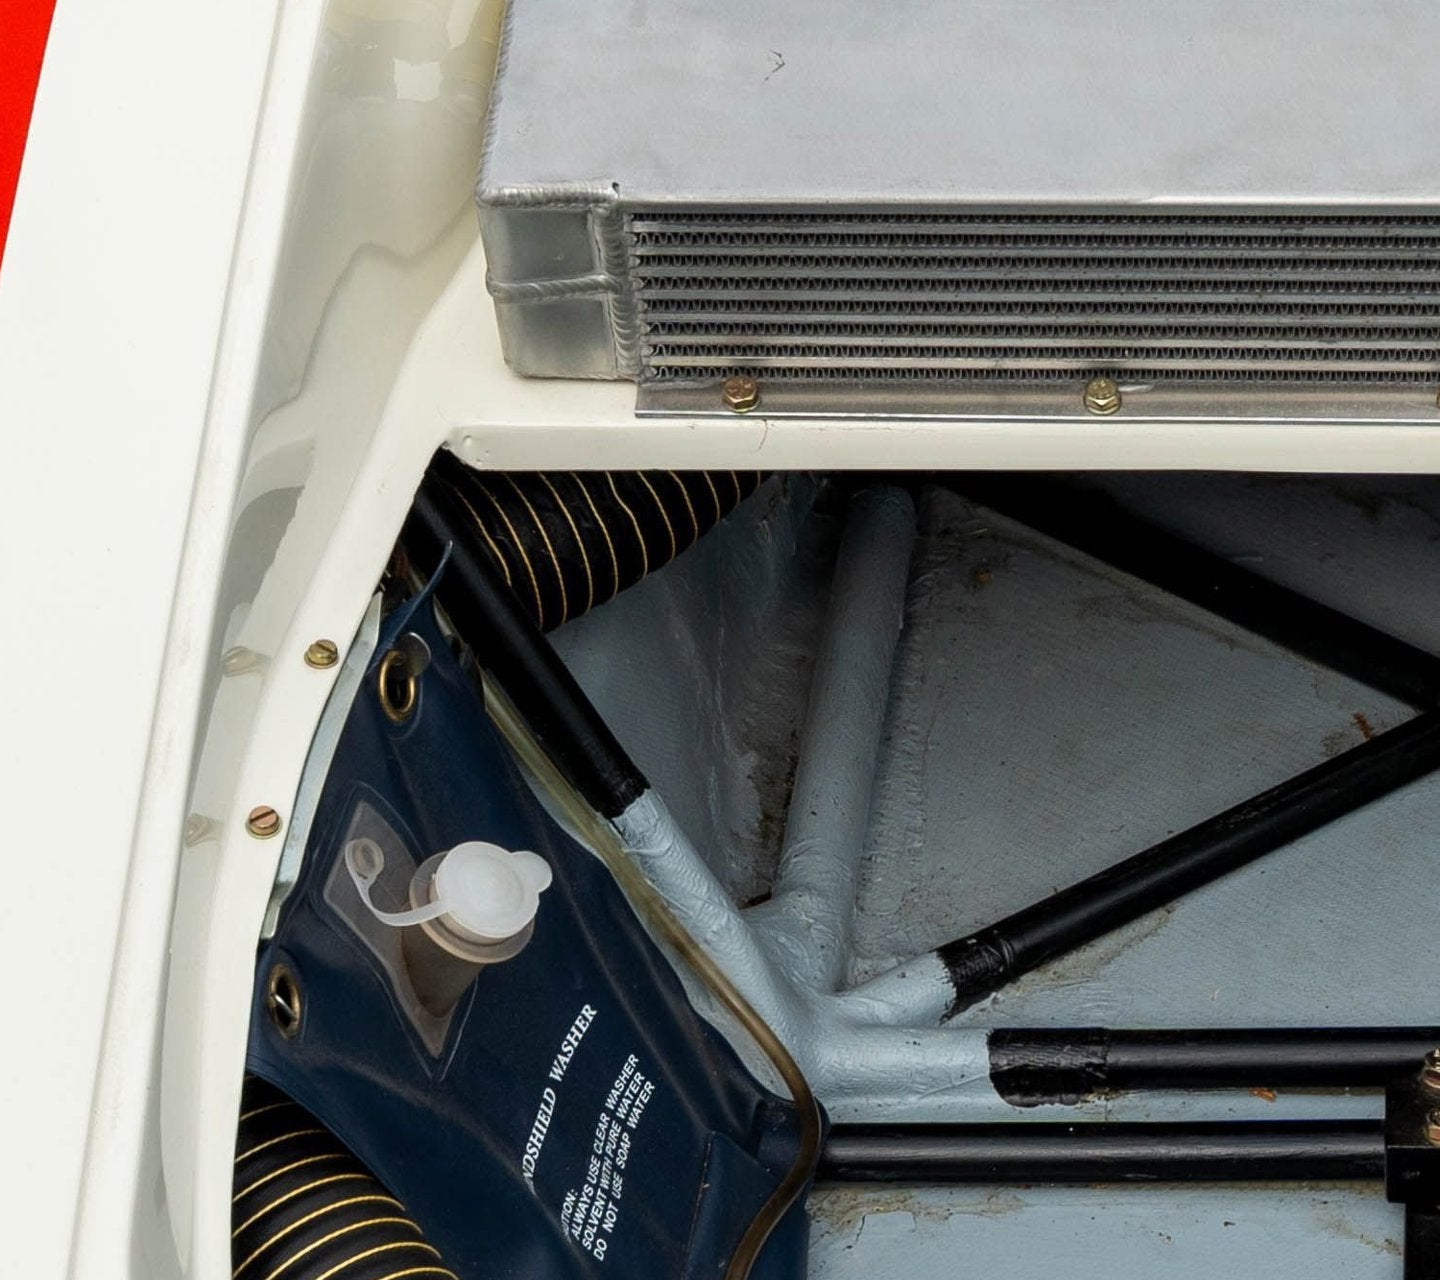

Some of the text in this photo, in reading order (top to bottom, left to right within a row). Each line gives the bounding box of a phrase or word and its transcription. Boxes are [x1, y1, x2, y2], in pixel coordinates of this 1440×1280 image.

[522, 1003, 598, 1192] NDSHIELD WASHER
[570, 1052, 640, 1241] ALWAYS USE CLEAR WASHER
[581, 1070, 646, 1251] SOLVENT WITH PURE WATER
[593, 1080, 657, 1262] DO NOT USE SOAP WATER
[560, 1188, 580, 1239] UTION:
